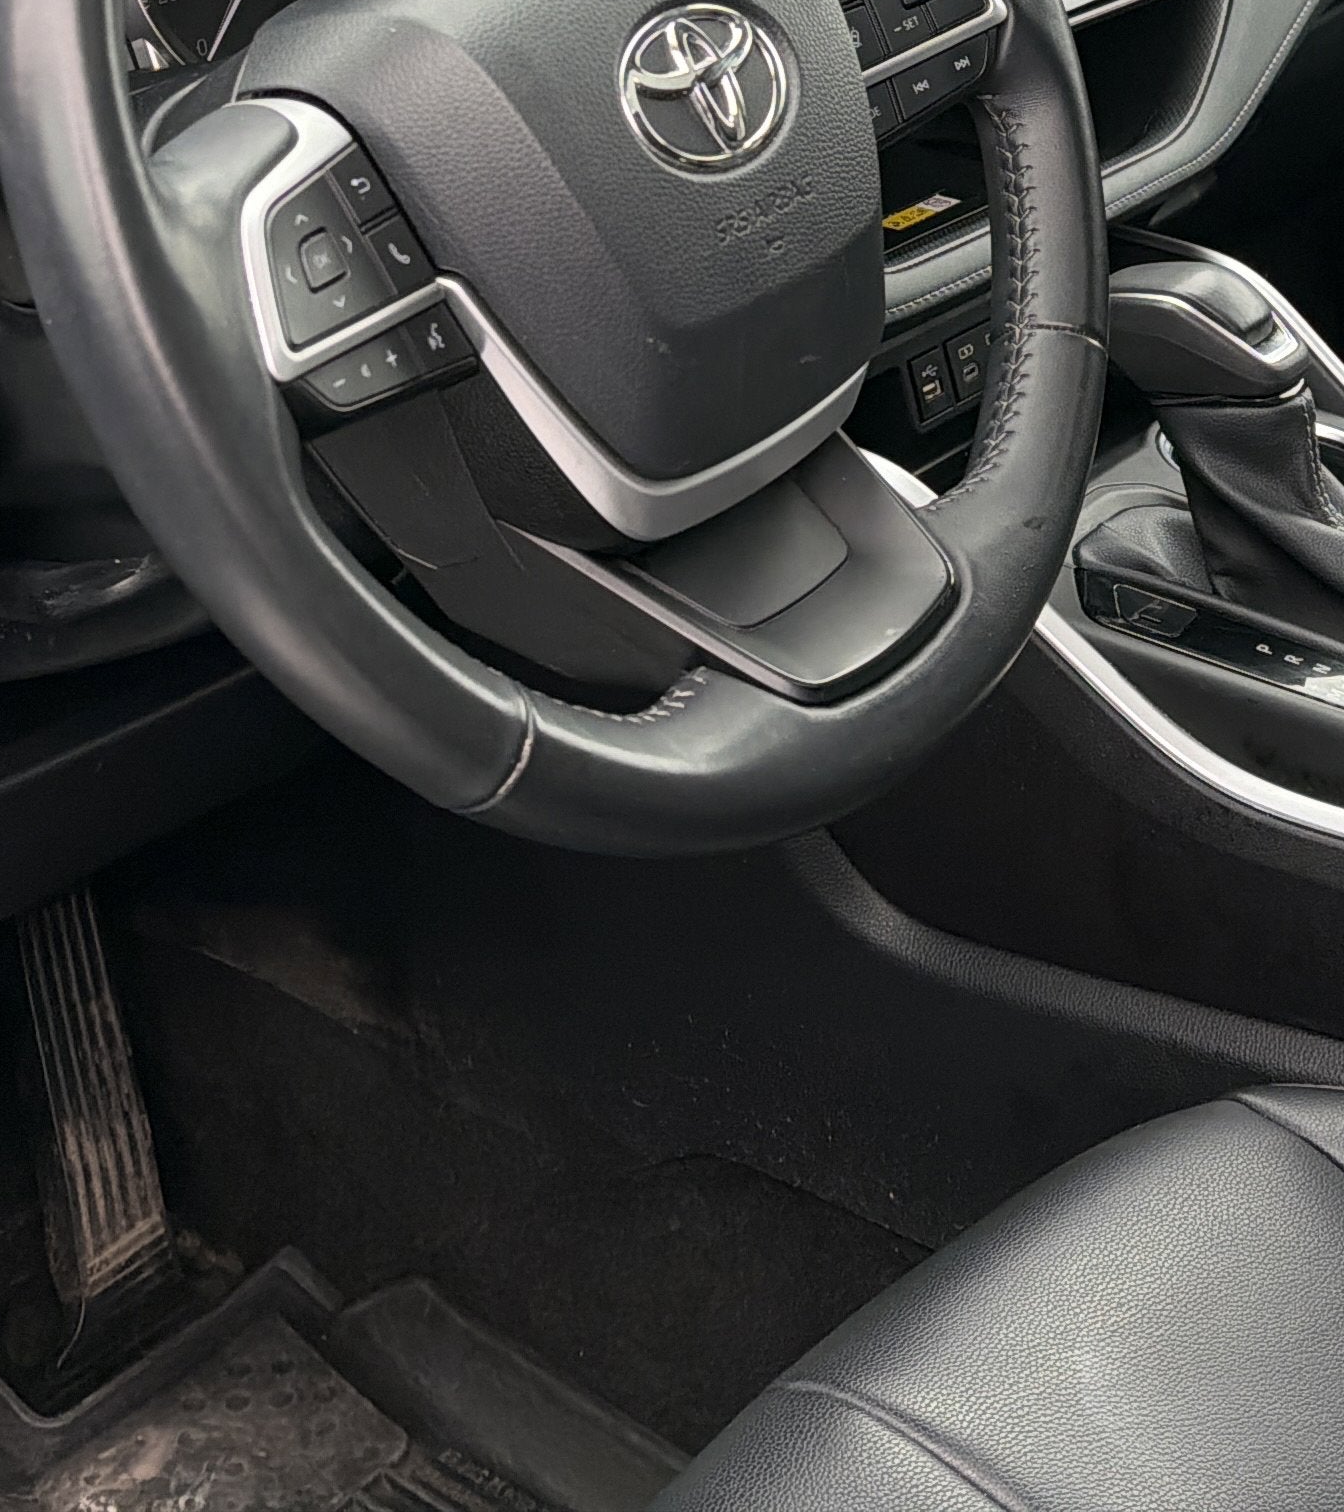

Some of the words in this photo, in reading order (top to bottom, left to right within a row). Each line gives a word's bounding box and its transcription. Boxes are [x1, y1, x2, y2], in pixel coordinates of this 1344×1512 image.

[196, 38, 208, 57] 0
[1256, 643, 1273, 656] P
[1283, 653, 1304, 666] R
[1312, 662, 1332, 675] N
